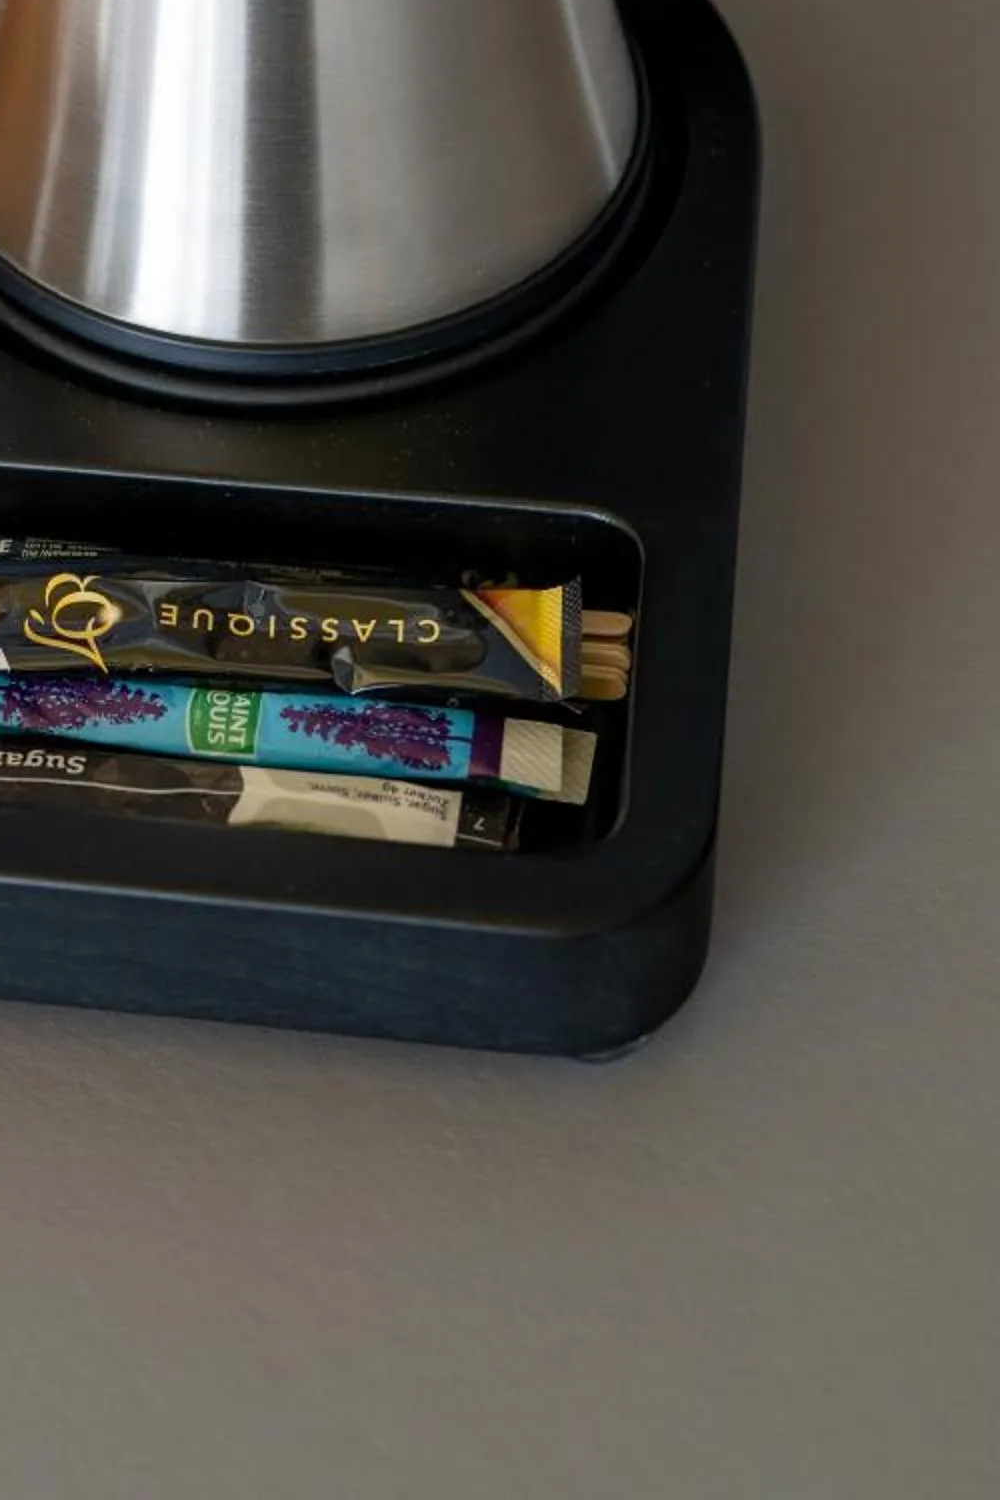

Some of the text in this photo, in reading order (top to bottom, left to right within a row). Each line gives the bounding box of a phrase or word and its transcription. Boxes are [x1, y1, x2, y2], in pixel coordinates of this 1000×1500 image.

[159, 603, 440, 645] CLASSIQUE
[207, 688, 231, 745] OUIS
[228, 688, 252, 749] AINT
